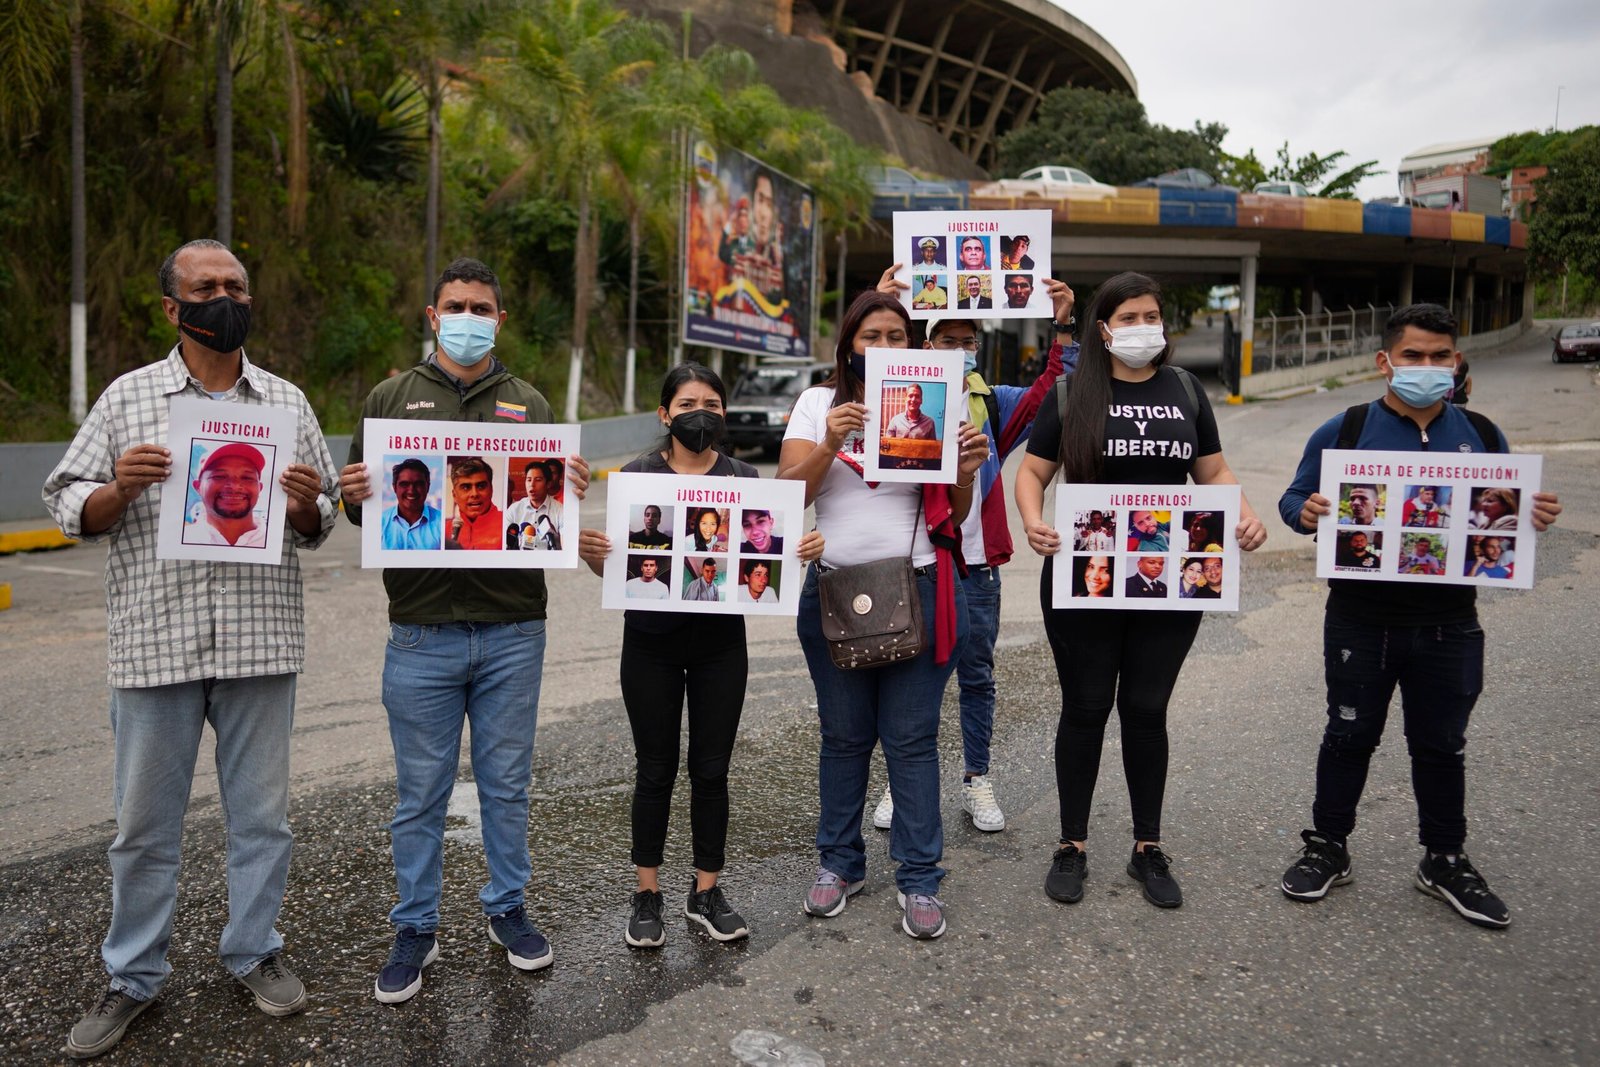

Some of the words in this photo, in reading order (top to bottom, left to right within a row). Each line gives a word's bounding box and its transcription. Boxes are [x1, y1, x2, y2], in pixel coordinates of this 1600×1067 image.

[948, 222, 1000, 232] ¡JUSTICIA!
[887, 365, 943, 377] ¡LIBERTAD!
[406, 401, 419, 410] José
[419, 400, 435, 409] Riera
[1109, 404, 1185, 420] USTICIA
[201, 421, 270, 438] ¡JUSTICIA!
[1134, 420, 1148, 435] Y
[388, 435, 438, 450] ¡BASTA
[443, 437, 461, 451] DE
[466, 437, 561, 453] PERSECUCIÓN!
[1103, 439, 1192, 460] IBERTAD
[1344, 463, 1391, 476] ¡BASTA
[1397, 465, 1413, 477] DE
[1420, 466, 1519, 480] PERSECUCIÓN!
[676, 489, 742, 504] ¡JUSTICIA!
[1109, 494, 1192, 507] ¡LIBERENLOS!
